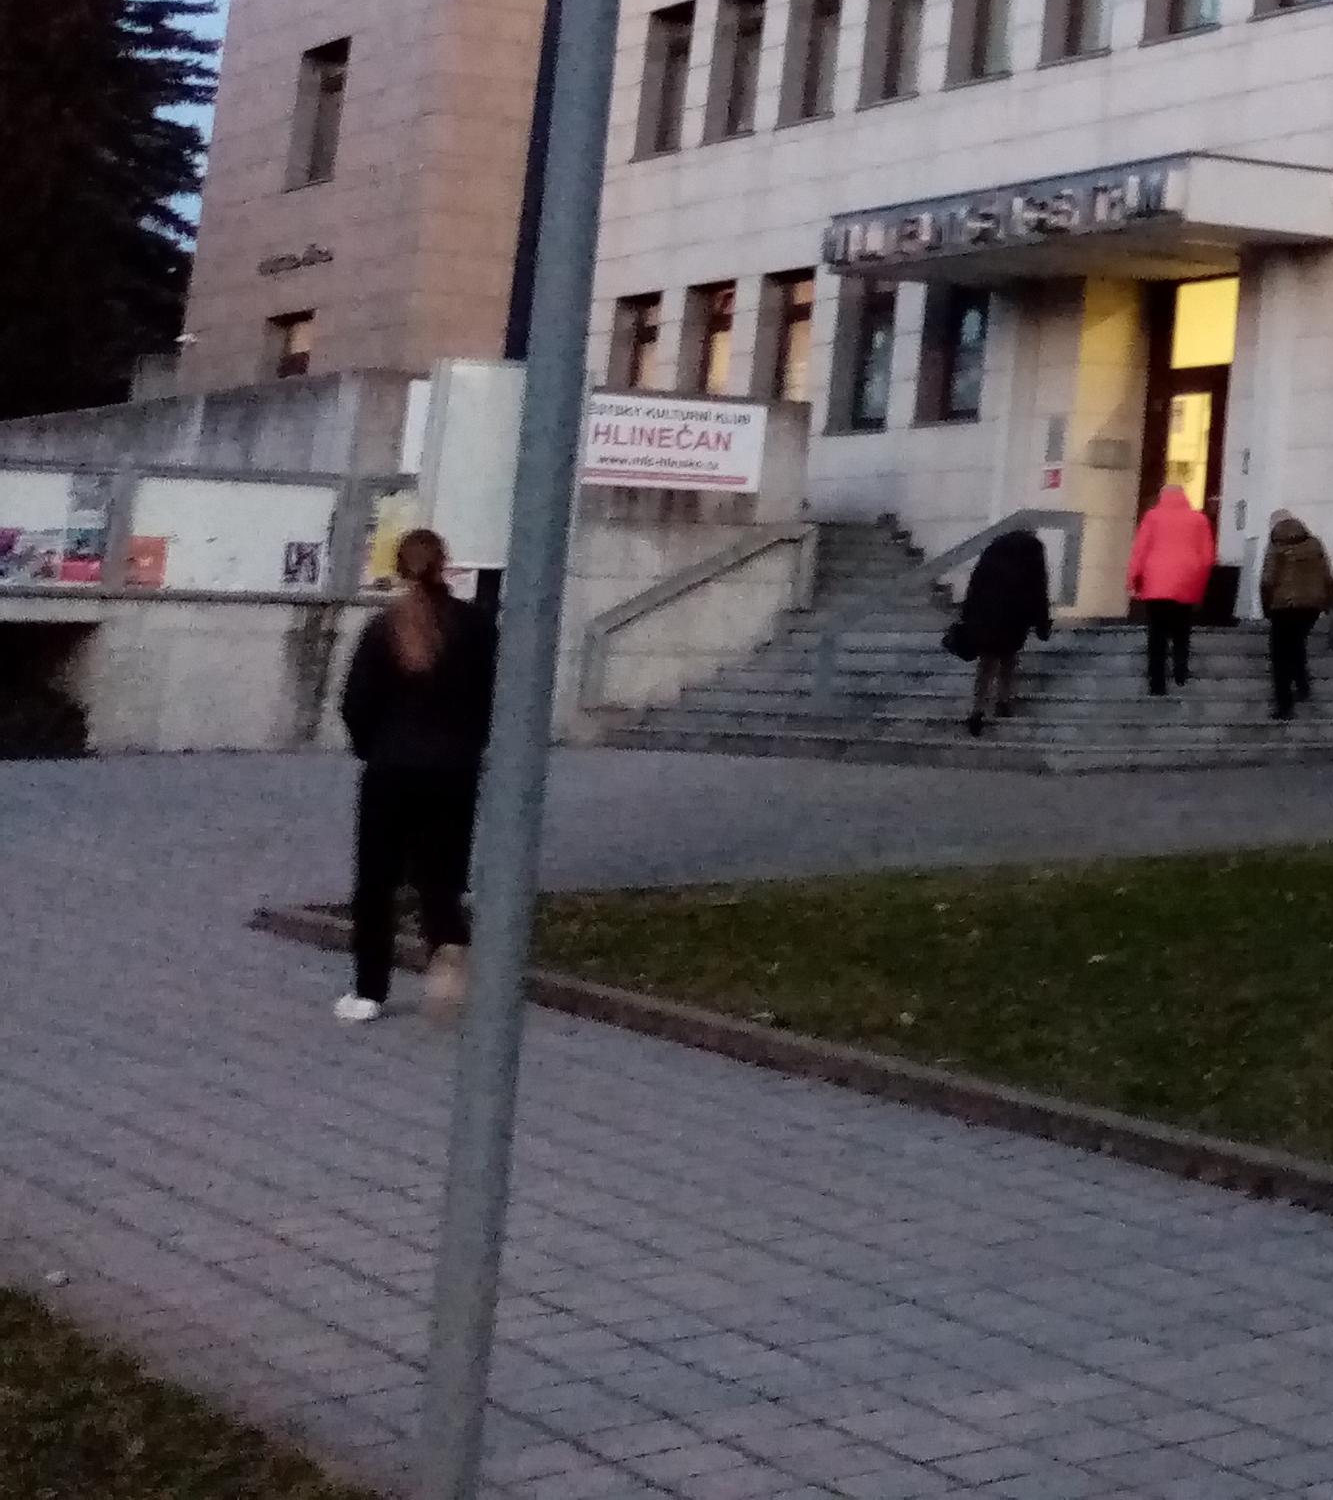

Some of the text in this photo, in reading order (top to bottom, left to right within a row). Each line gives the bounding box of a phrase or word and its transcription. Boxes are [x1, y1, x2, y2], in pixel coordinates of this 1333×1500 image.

[585, 401, 642, 418] ĚSTSKÝ
[715, 411, 751, 425] KLUB
[591, 423, 734, 451] HLINEČAN
